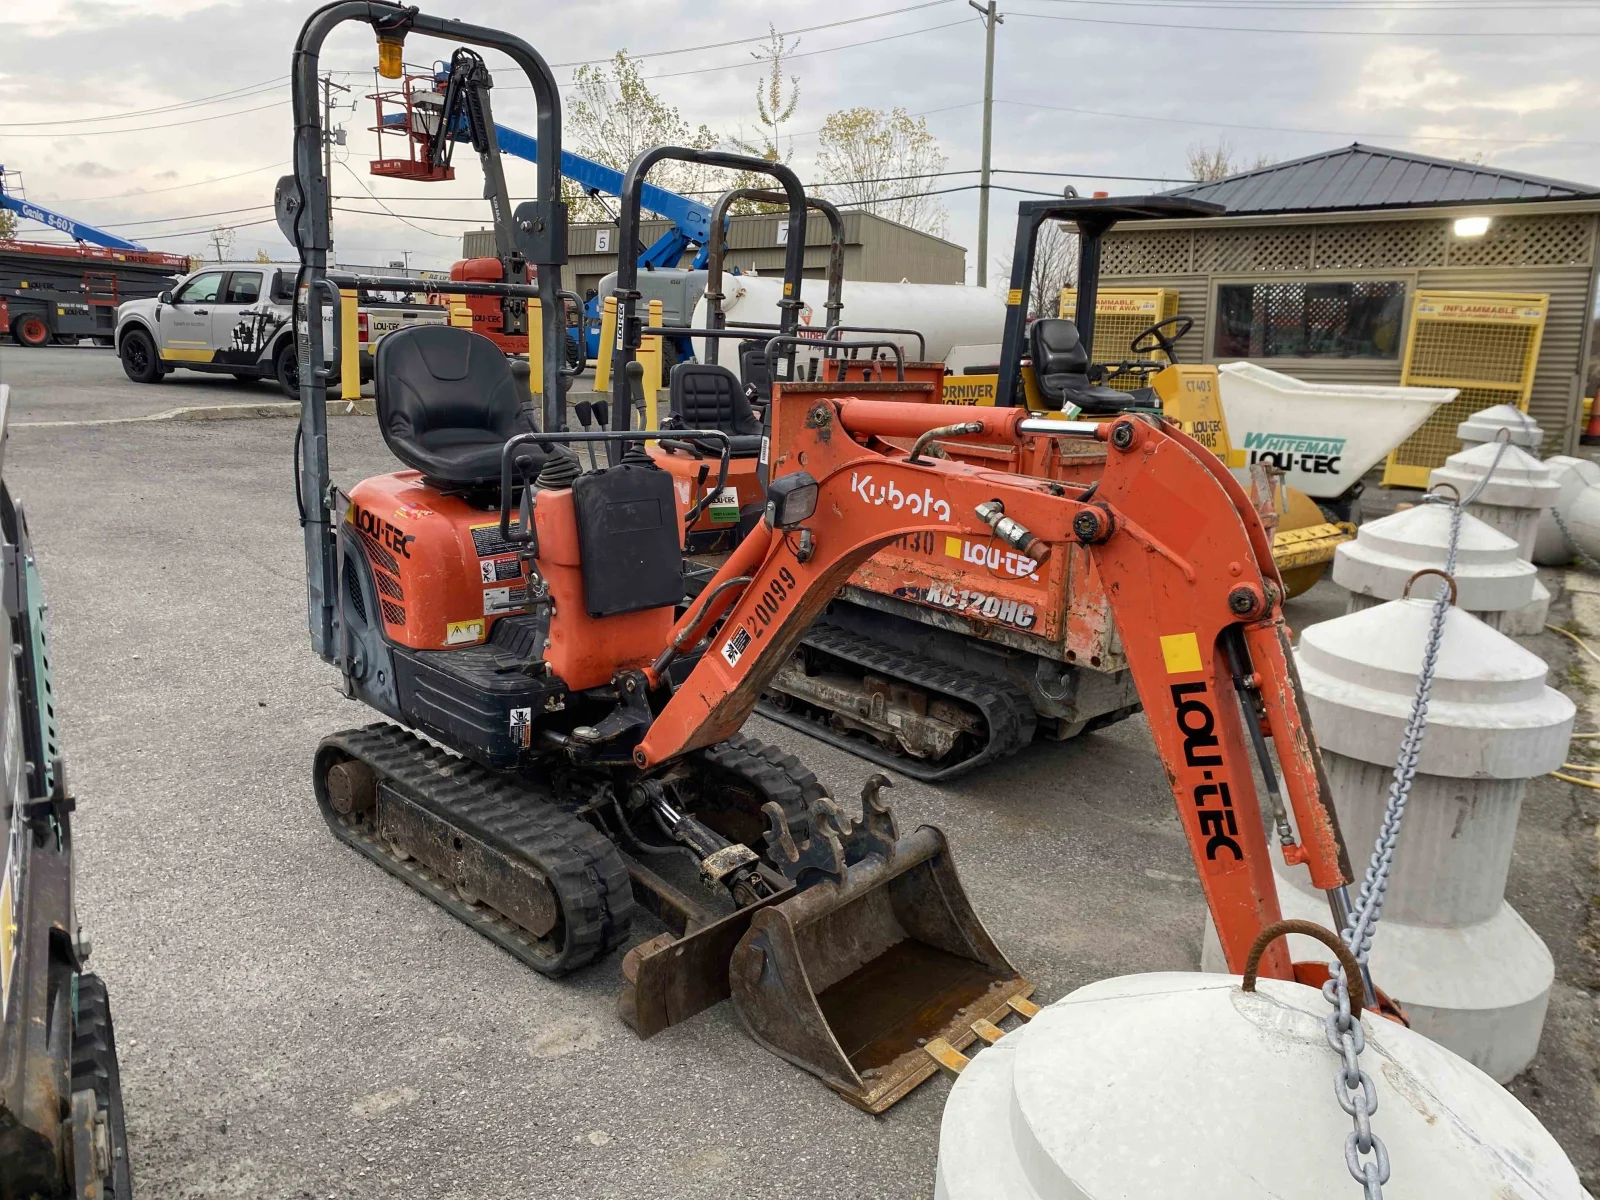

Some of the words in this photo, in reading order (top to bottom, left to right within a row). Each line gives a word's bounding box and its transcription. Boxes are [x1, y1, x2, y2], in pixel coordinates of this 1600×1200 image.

[22, 205, 44, 221] Genie
[599, 237, 606, 249] 5
[782, 229, 789, 240] 7
[1443, 304, 1518, 315] INFLAMMABLE
[374, 322, 399, 330] LOU-TEC
[1193, 420, 1221, 433] LOU-TEC
[1244, 432, 1346, 454] WHITEMAN
[1250, 450, 1341, 474] LOU-TEC
[851, 472, 950, 522] Kubota
[355, 505, 416, 559] LOU-TEC
[963, 541, 1039, 581] LOU-TEC
[747, 566, 796, 639] 20099
[1170, 682, 1243, 861] LOU-TEC
